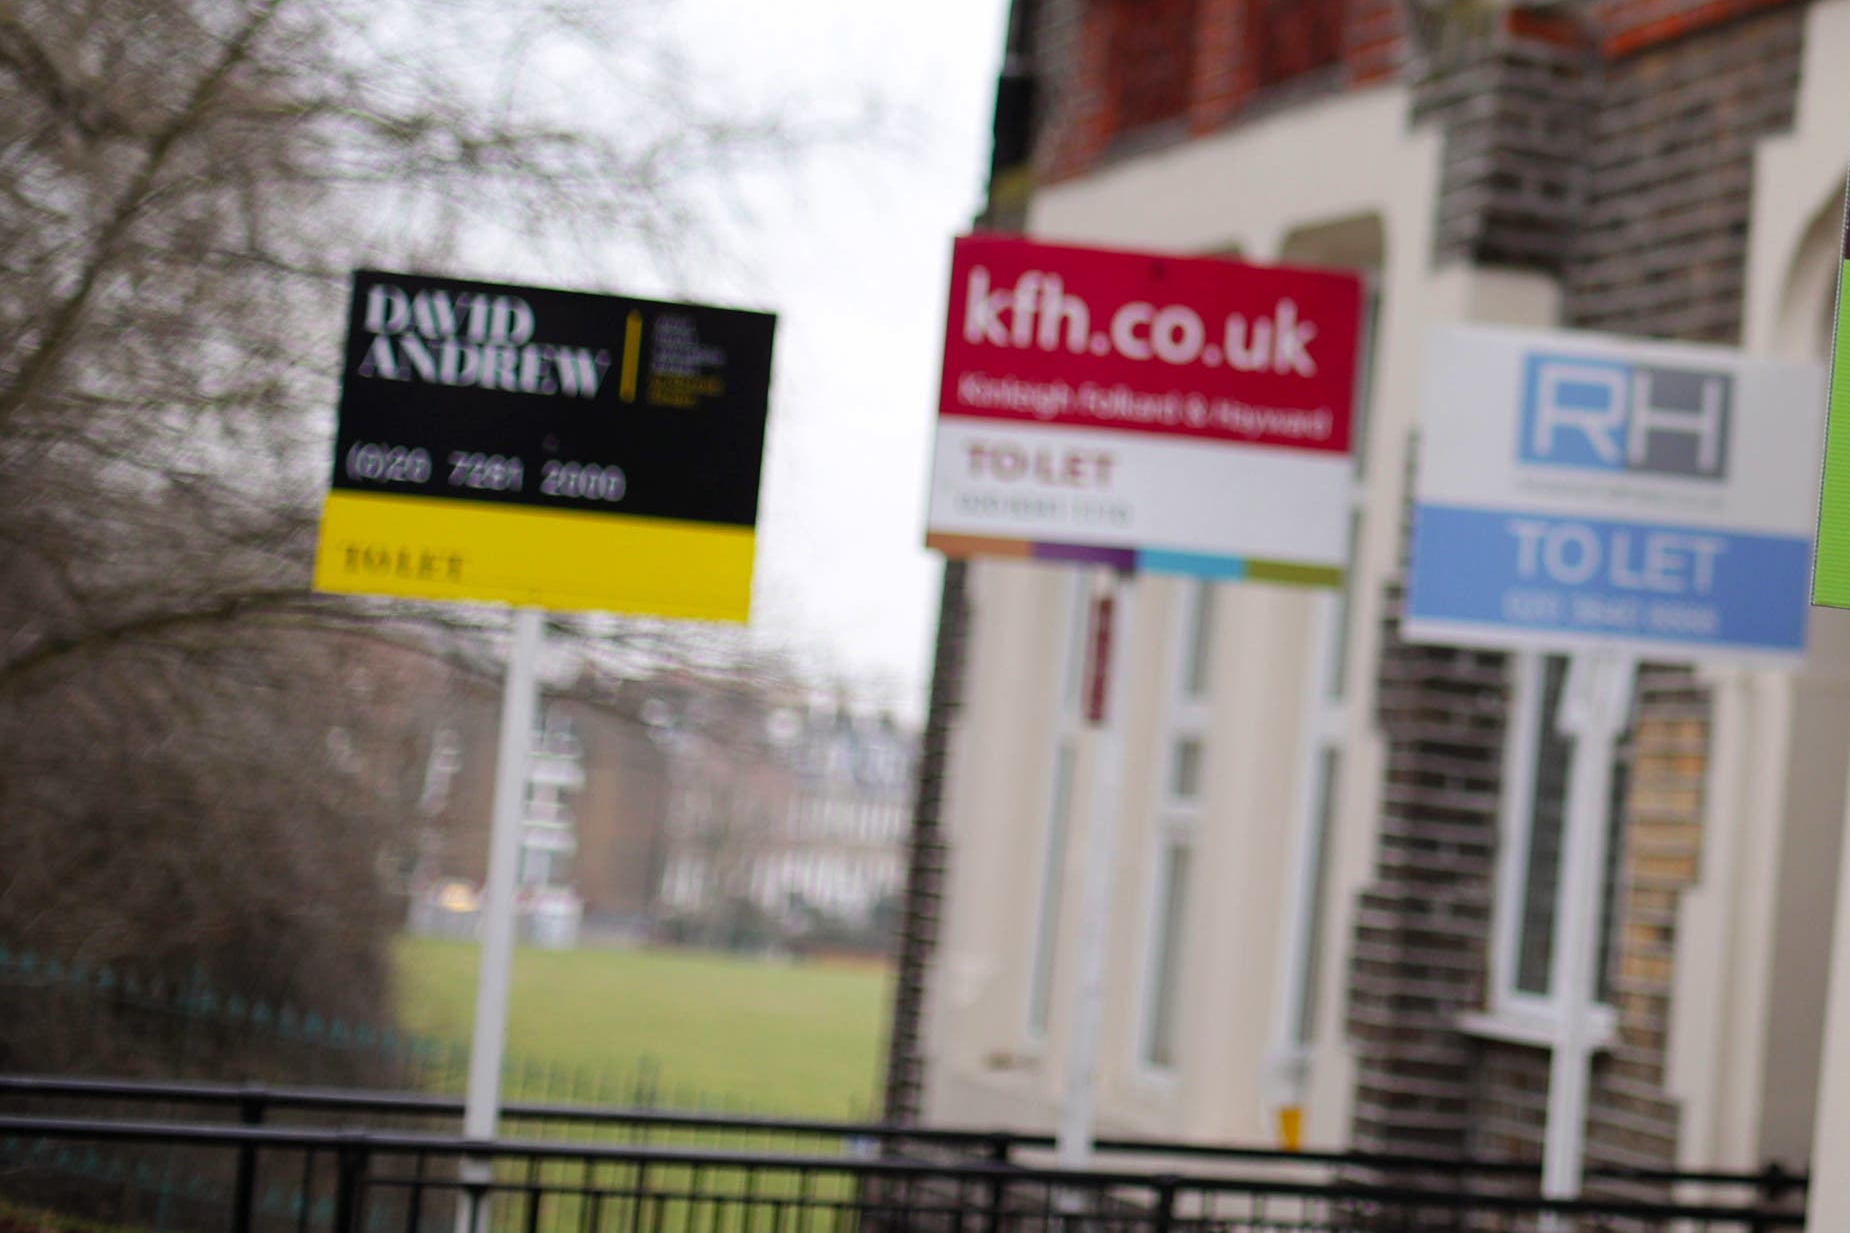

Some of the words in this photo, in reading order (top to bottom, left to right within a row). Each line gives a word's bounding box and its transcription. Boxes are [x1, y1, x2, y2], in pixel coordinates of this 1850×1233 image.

[364, 283, 535, 346] DAVID
[963, 266, 1319, 378] kfh.co.uk
[358, 332, 612, 399] ANDREW
[1533, 363, 1721, 473] RH
[540, 460, 627, 502] 2000
[964, 438, 1029, 482] TO
[1034, 446, 1117, 488] LET
[1506, 519, 1600, 585] TO
[1609, 526, 1728, 596] LET
